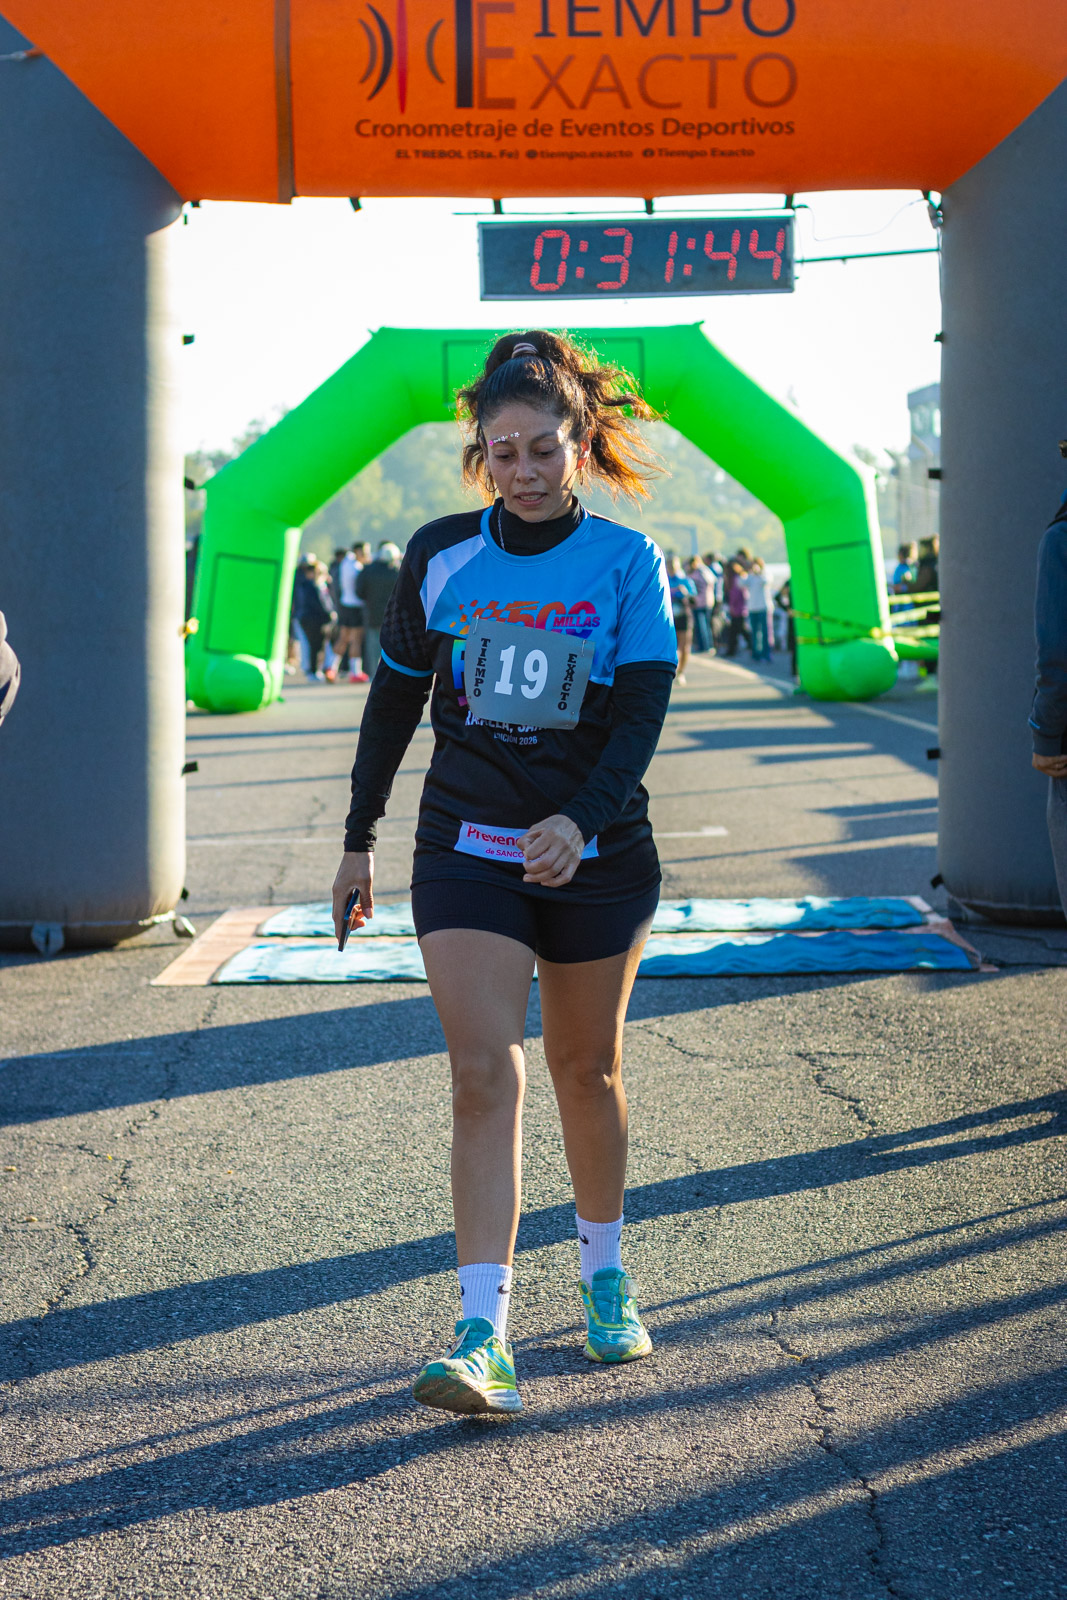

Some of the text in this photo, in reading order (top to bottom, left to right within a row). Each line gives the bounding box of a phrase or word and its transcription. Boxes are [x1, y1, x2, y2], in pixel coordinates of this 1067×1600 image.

[355, 117, 795, 141] Cronometraje de Eventos Deportivos
[395, 149, 410, 159] EL
[500, 149, 519, 160] Fe)
[658, 147, 755, 159] Tiempo Exacto
[553, 616, 600, 628] MILLAS
[473, 638, 491, 698] TIEMPO
[494, 645, 548, 699] 19
[557, 653, 577, 711] EXACTO
[520, 735, 538, 745] 2026
